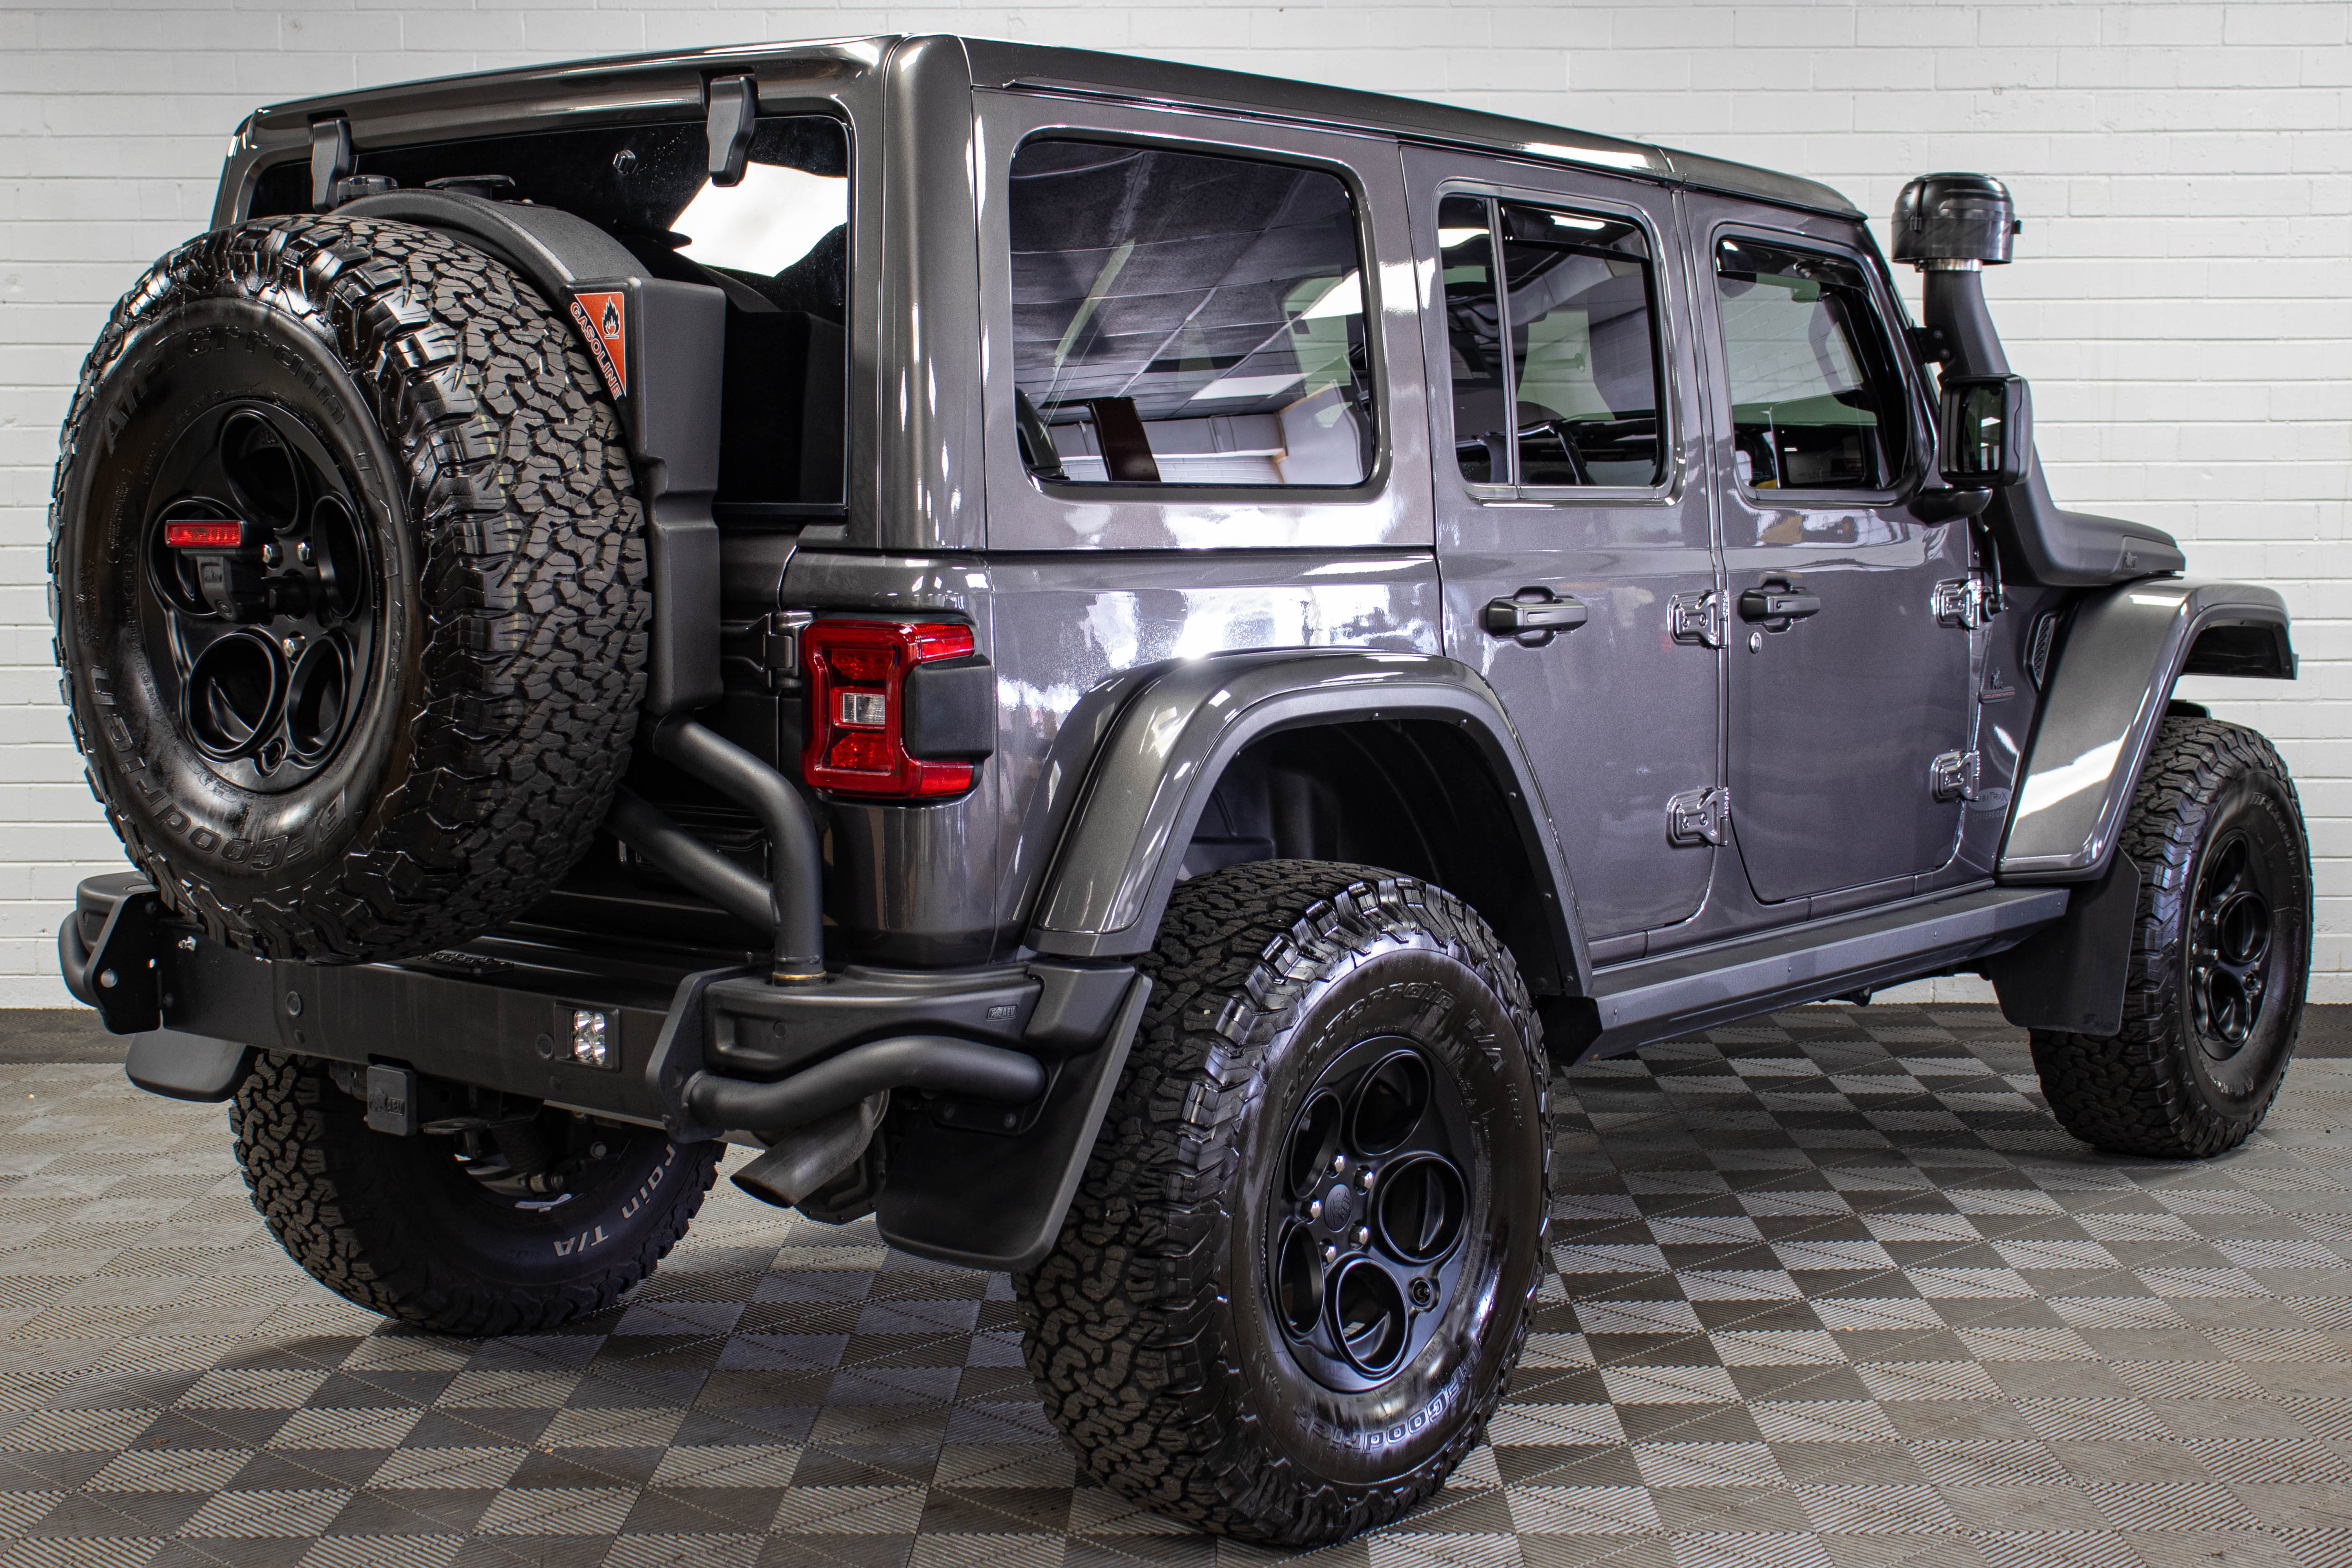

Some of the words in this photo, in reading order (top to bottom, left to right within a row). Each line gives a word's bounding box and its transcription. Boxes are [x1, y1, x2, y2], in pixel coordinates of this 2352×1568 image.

[103, 324, 346, 458] All-Terrain
[570, 302, 622, 401] GASOLINE
[146, 686, 163, 717] RANGE
[90, 665, 347, 870] BFGoodrich
[1282, 981, 1456, 1115] All-Terrain
[1464, 1009, 1507, 1074] T/A
[553, 1225, 609, 1257] T/A
[1294, 1338, 1482, 1454] BFGoodrich
